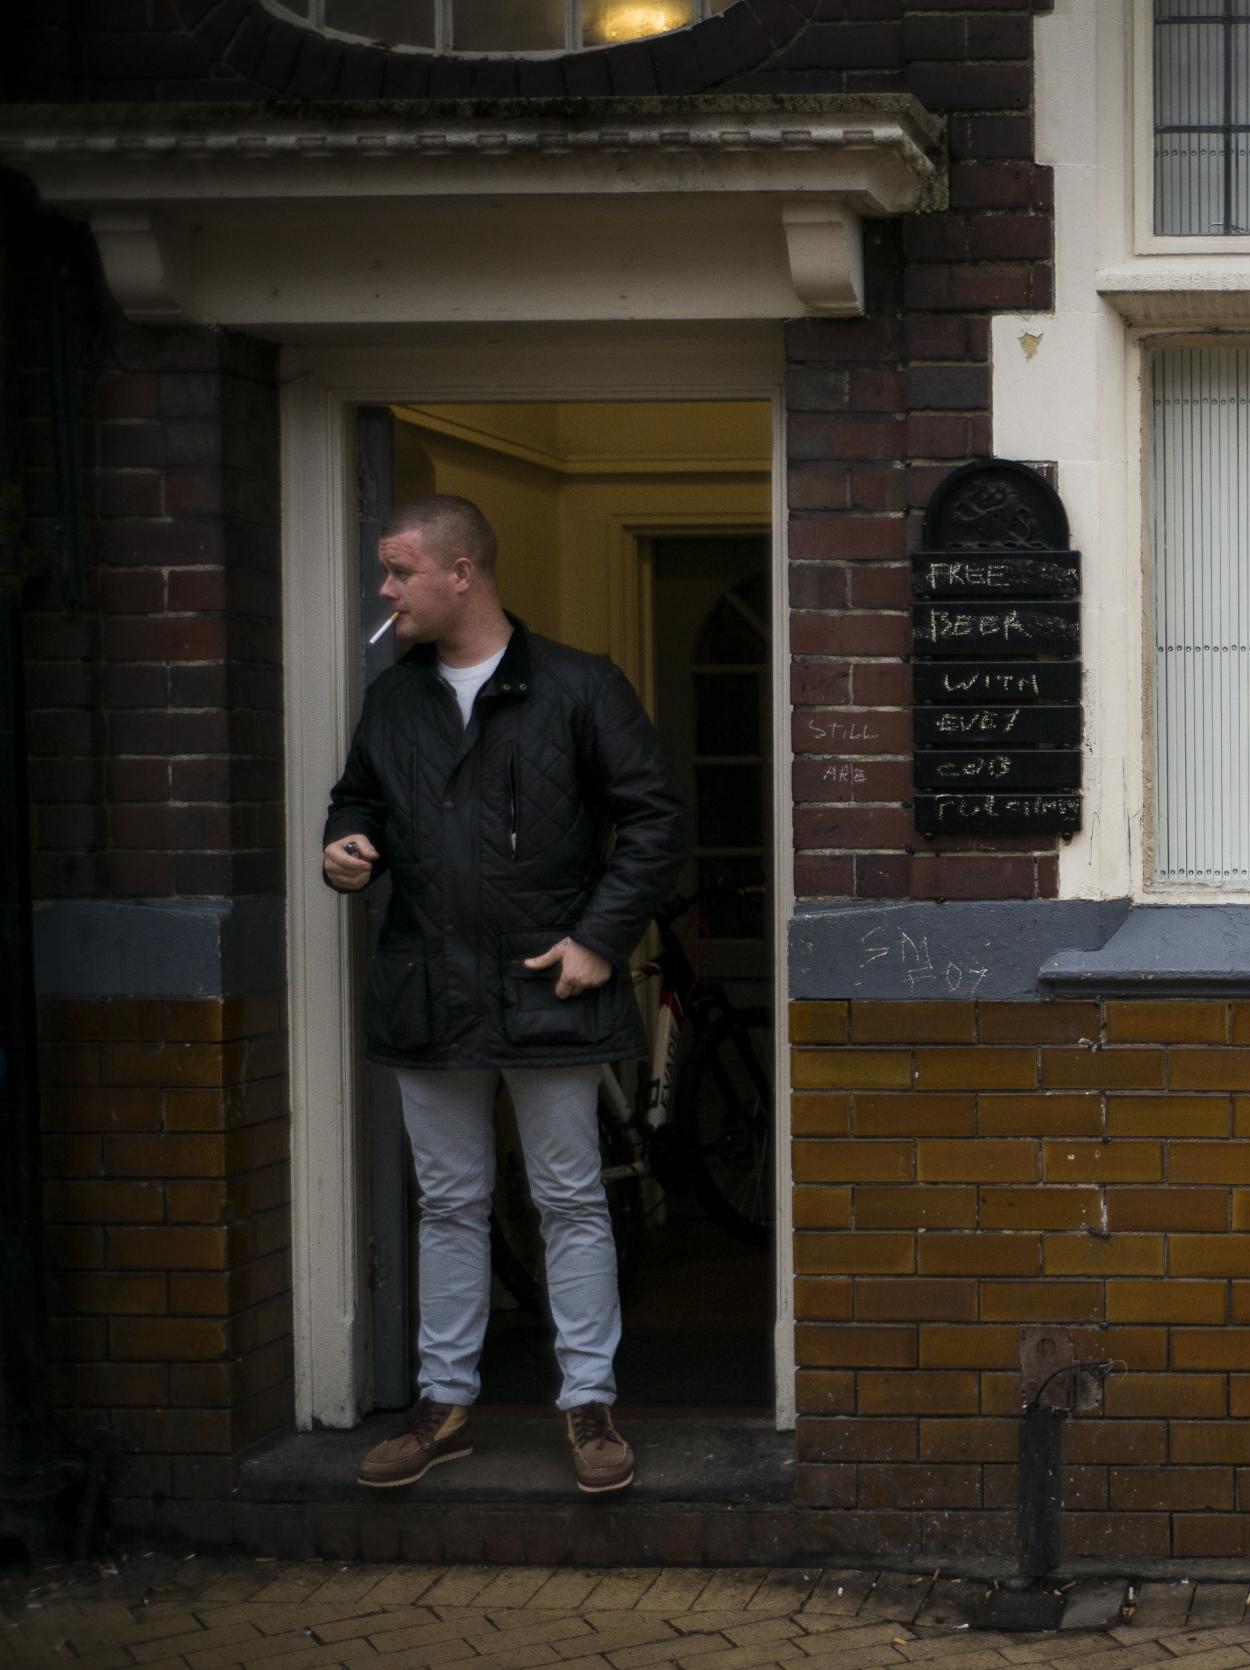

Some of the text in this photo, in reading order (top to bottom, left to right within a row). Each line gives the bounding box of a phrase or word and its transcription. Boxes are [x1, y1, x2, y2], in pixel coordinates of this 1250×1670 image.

[926, 563, 1010, 589] FREE
[931, 608, 1032, 642] BEER
[944, 673, 1038, 695] WITH
